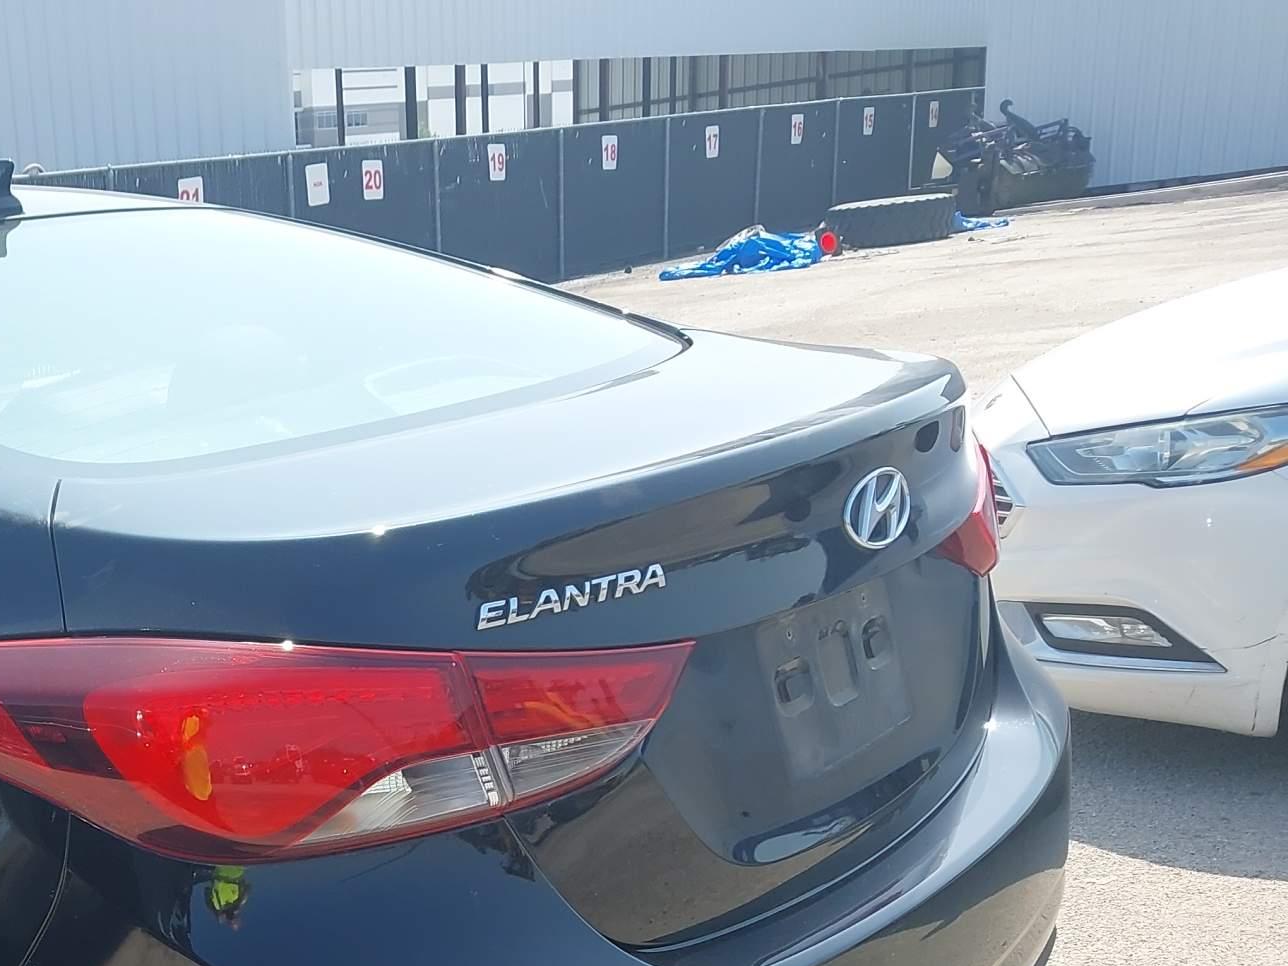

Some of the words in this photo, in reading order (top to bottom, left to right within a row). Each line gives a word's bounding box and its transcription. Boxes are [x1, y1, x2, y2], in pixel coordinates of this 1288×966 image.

[865, 112, 873, 128] 15
[793, 121, 803, 137] 16
[707, 134, 718, 150] 17
[604, 144, 616, 161] 18
[490, 153, 505, 171] 19
[364, 170, 382, 190] 20
[477, 563, 666, 631] ELANTRA
